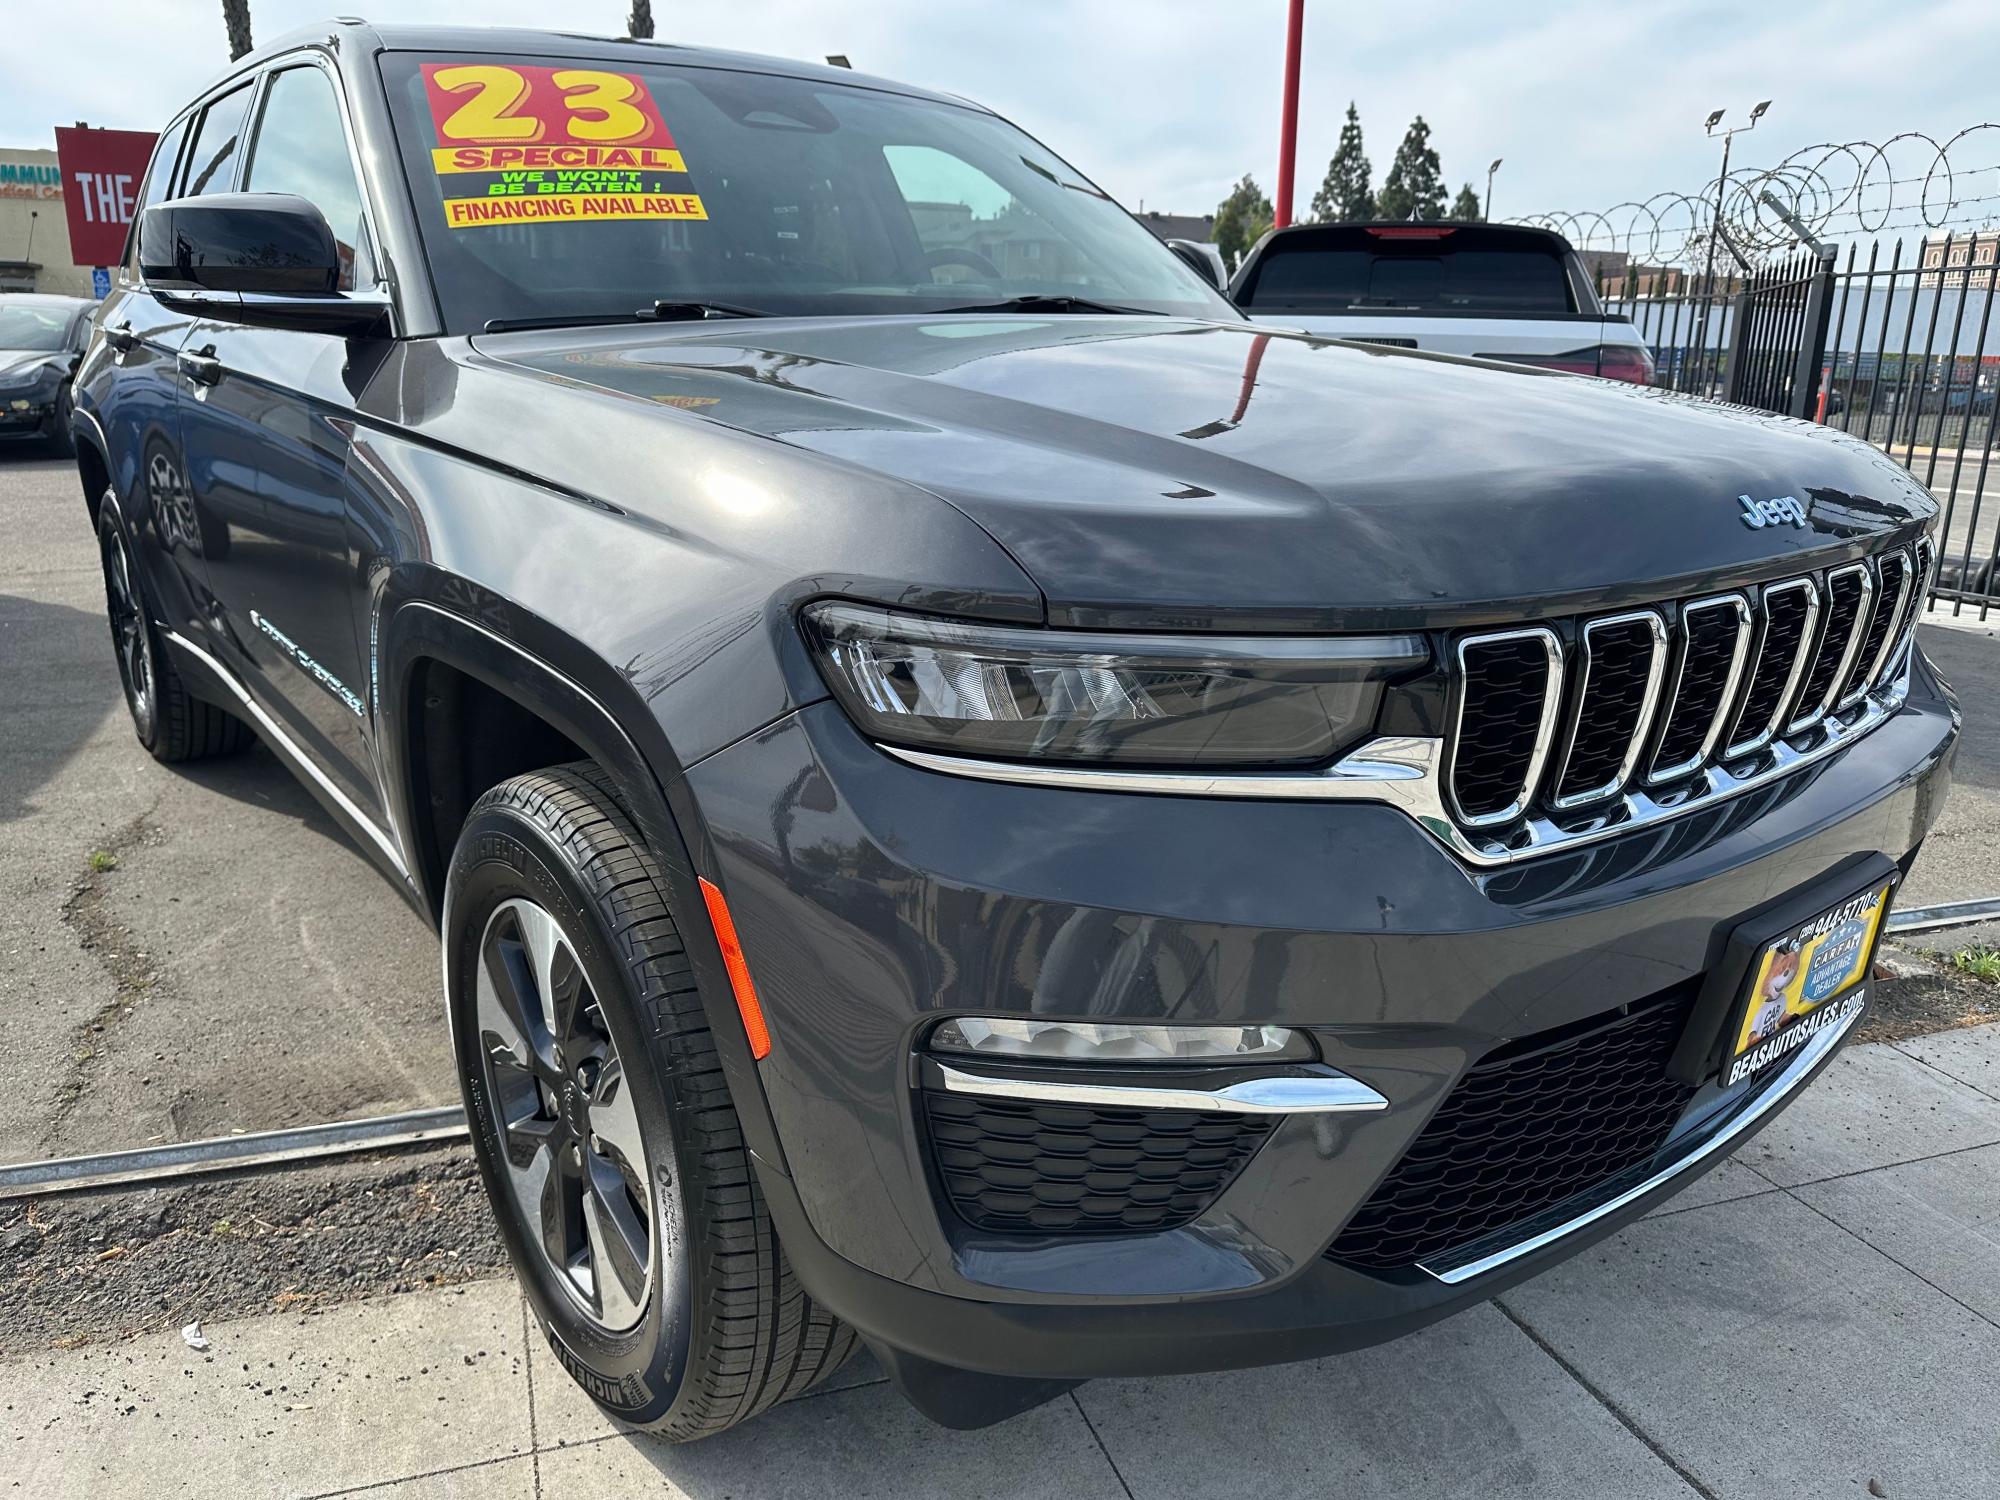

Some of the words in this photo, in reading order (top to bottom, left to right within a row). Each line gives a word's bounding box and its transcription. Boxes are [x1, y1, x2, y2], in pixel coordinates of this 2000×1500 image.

[433, 65, 653, 142] 23
[453, 148, 672, 170] SPECIAL
[488, 183, 524, 195] BE
[537, 182, 642, 194] BEATEN
[502, 172, 544, 184] WE
[557, 171, 641, 182] WON'T
[75, 172, 134, 224] THE
[451, 199, 575, 222] FINANCING
[582, 198, 699, 215] AVAILABLE
[1739, 494, 1806, 529] Jeep
[1814, 931, 1862, 969] CARFAX
[1811, 952, 1852, 985] ADVANTAGE
[1813, 972, 1842, 997] DEALER
[1764, 1004, 1781, 1026] CAR
[551, 1338, 624, 1405] MICHELIN
